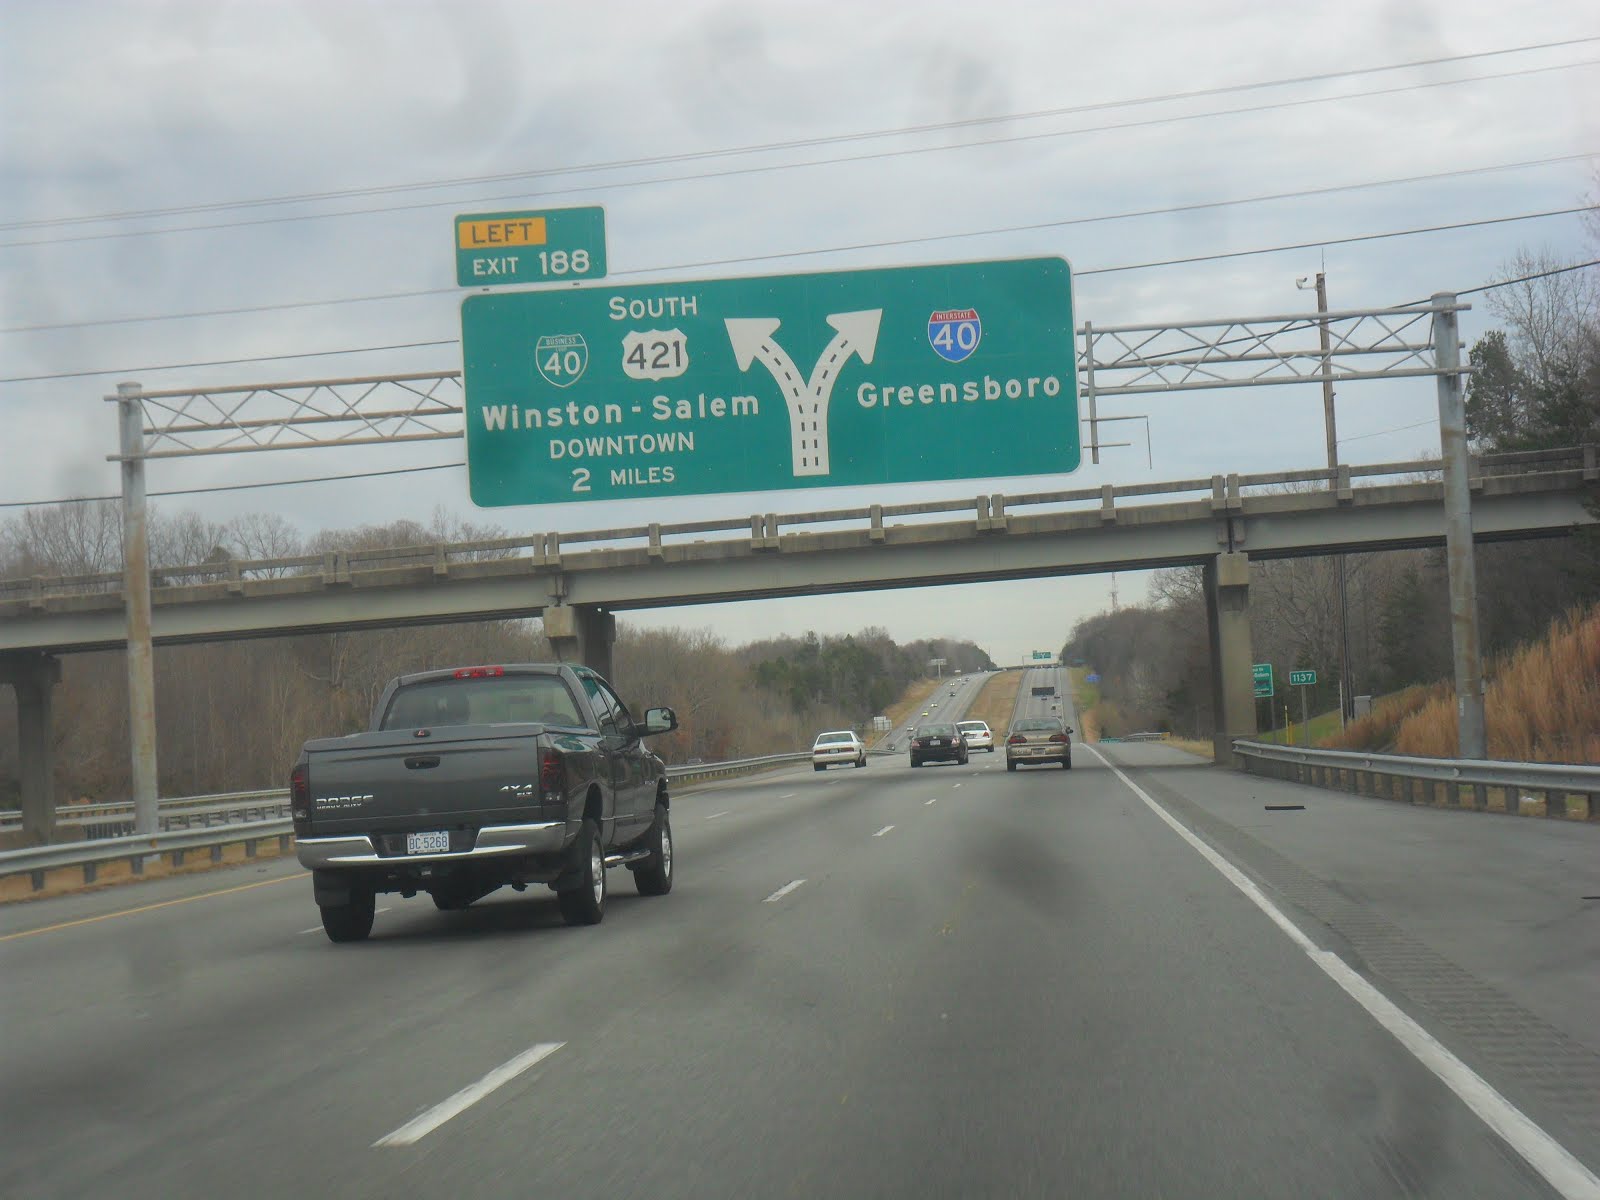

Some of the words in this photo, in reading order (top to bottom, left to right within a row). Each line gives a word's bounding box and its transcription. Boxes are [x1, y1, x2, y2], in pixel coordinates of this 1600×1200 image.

[472, 222, 533, 244] LEFT
[473, 256, 519, 276] EXIT
[538, 248, 590, 275] 188
[608, 295, 698, 320] SOUTH
[936, 311, 971, 320] INTERSTATE
[545, 337, 577, 346] BUSINESS
[933, 322, 976, 350] 40
[544, 351, 581, 376] 40
[626, 340, 681, 370] 421
[856, 375, 1060, 408] Greensboro
[550, 431, 695, 459] DOWNTOWN
[572, 467, 591, 492] 2
[610, 466, 675, 486] MILES
[1292, 673, 1313, 682] 1137
